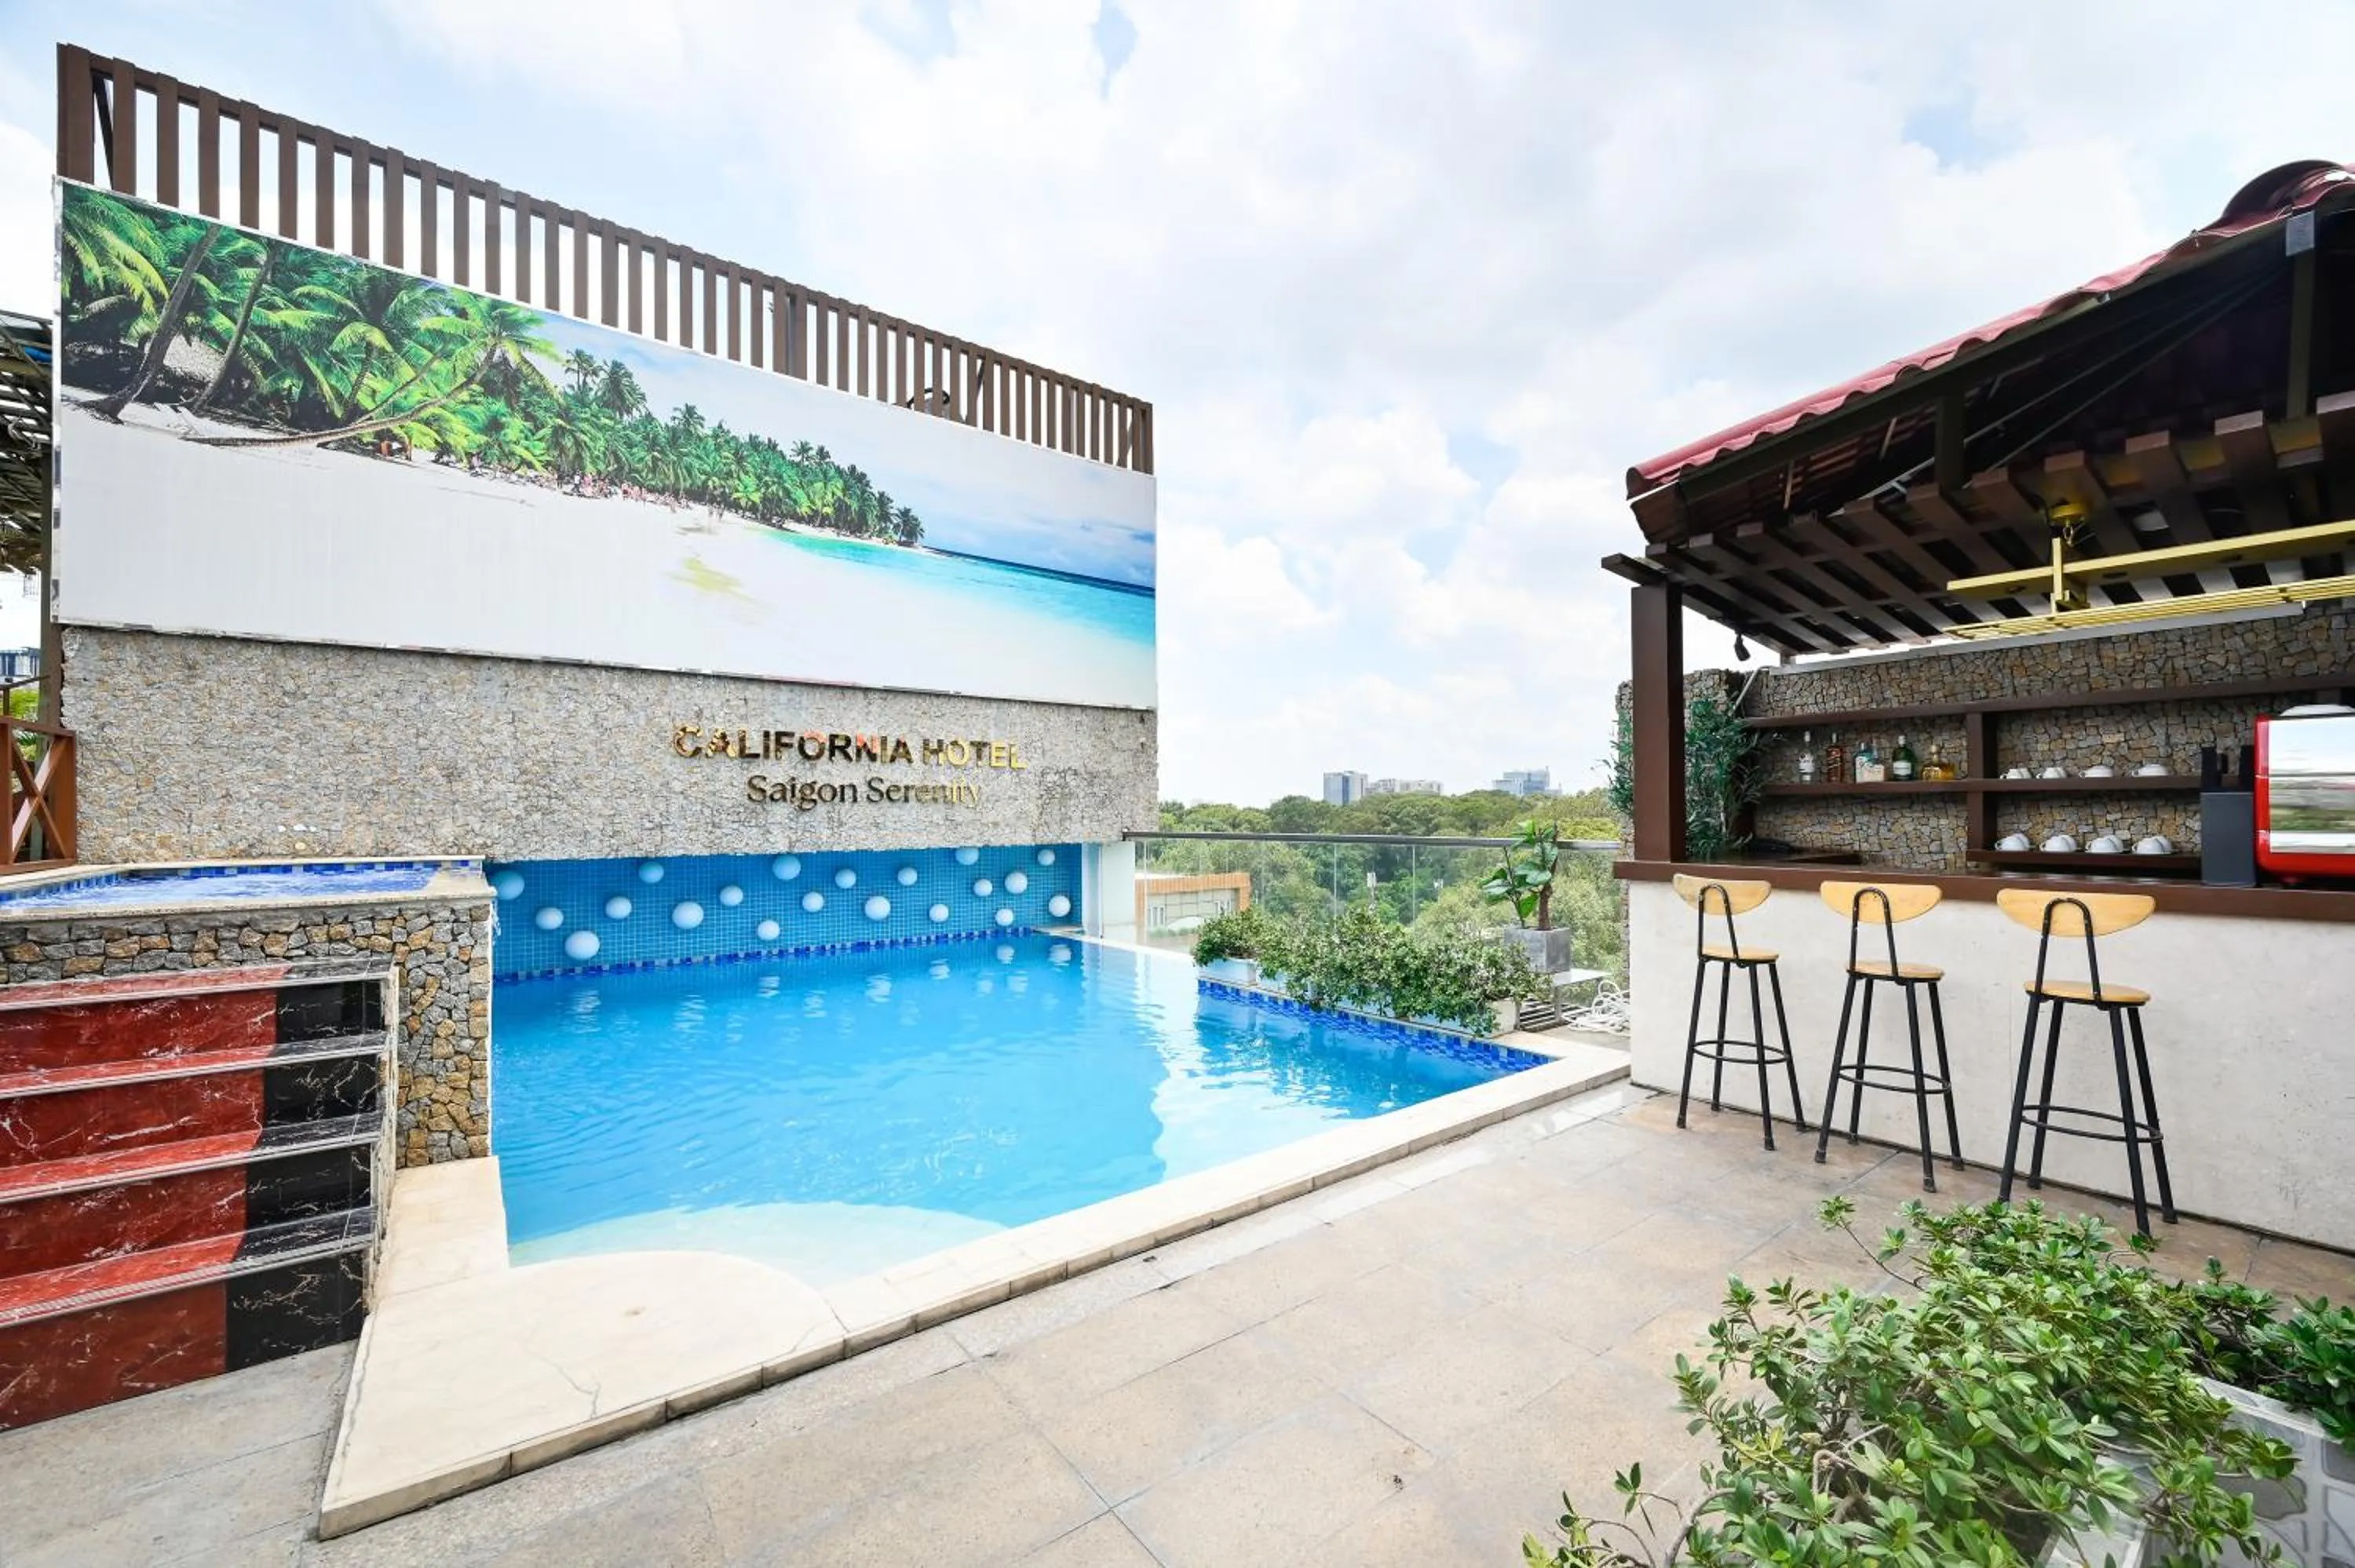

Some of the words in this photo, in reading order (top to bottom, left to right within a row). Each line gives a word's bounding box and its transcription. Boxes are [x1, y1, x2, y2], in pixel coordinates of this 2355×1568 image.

[673, 726, 913, 764] CALIFORNIA
[922, 738, 1027, 769] HOTEL
[747, 775, 858, 810] Saigon
[866, 776, 981, 806] Serenity
